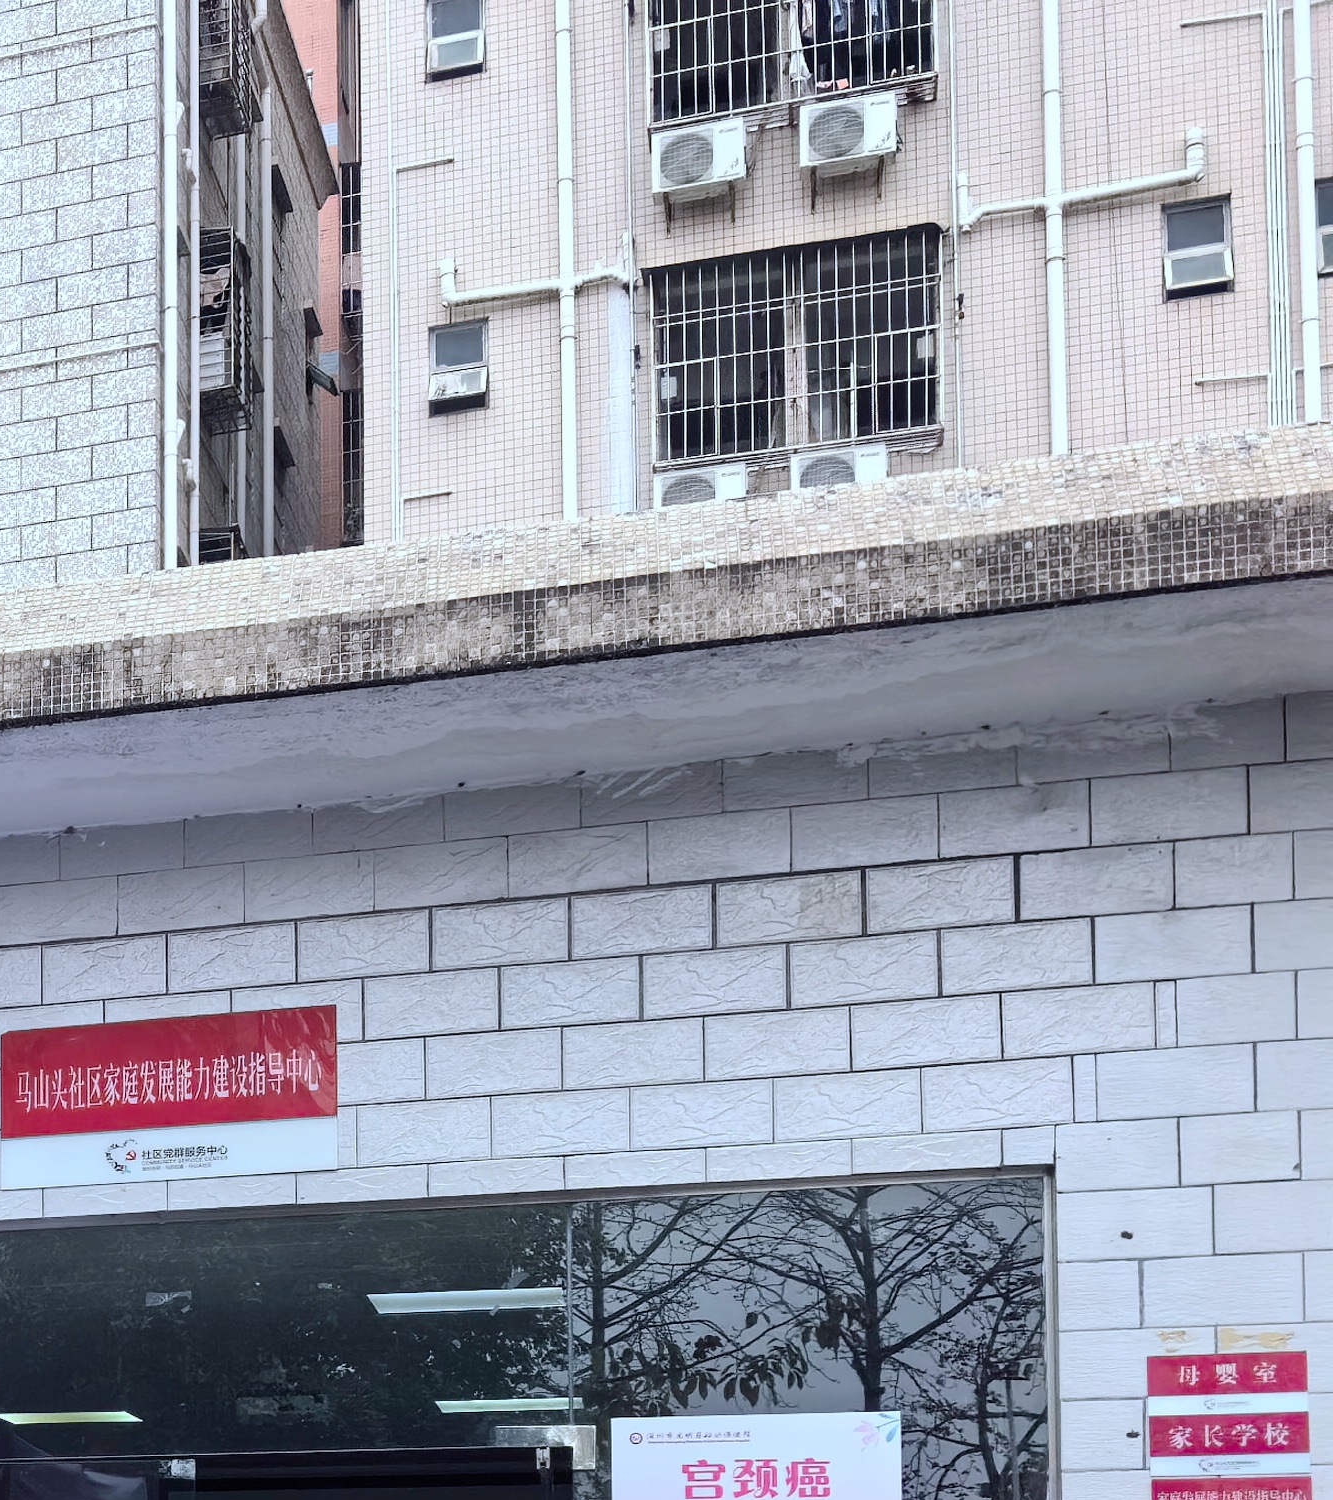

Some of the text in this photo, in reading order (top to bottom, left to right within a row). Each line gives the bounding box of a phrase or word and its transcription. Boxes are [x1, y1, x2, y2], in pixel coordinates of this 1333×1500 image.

[15, 1049, 320, 1113] 马山头社区家庭发展能力建设指导中心
[141, 1145, 228, 1160] 社区党群服务中心
[1178, 1362, 1277, 1386] 母婴室
[1169, 1421, 1290, 1449] 家长学校
[681, 1457, 831, 1500] 宫颈癌
